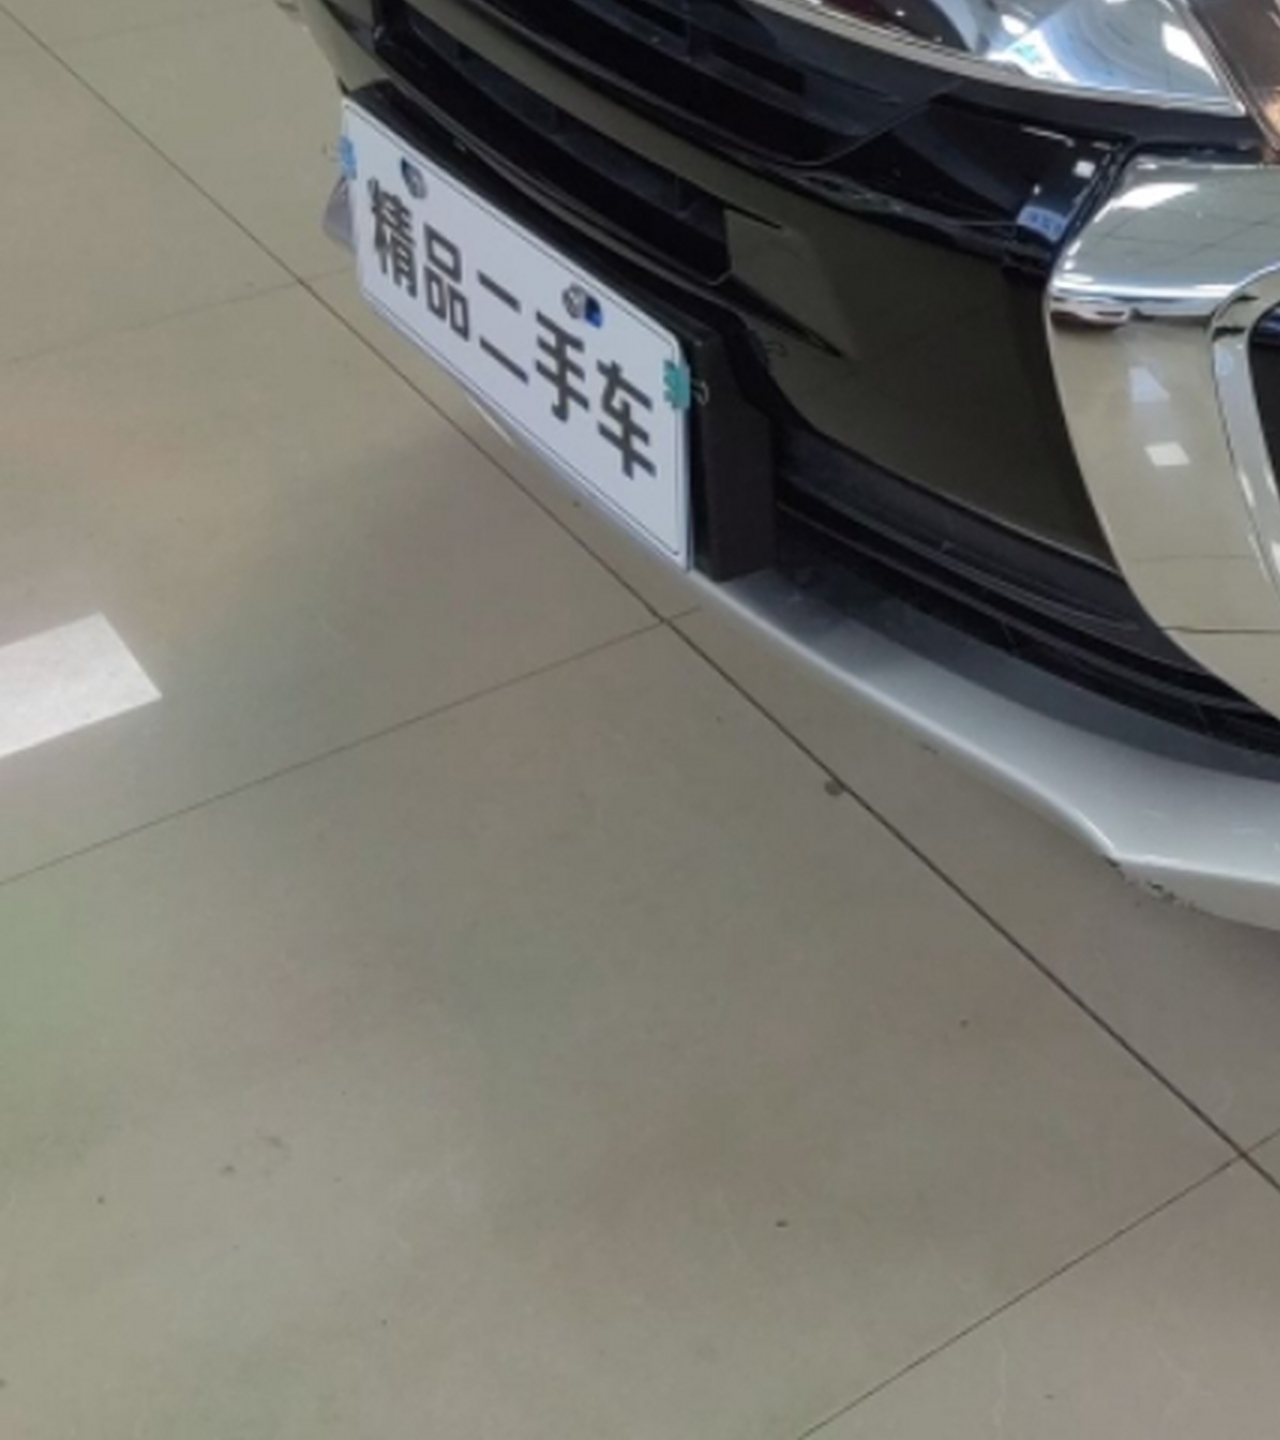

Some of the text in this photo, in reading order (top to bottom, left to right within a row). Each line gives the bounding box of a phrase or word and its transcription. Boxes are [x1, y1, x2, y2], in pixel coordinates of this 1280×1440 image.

[367, 176, 657, 480] 精品二手车
